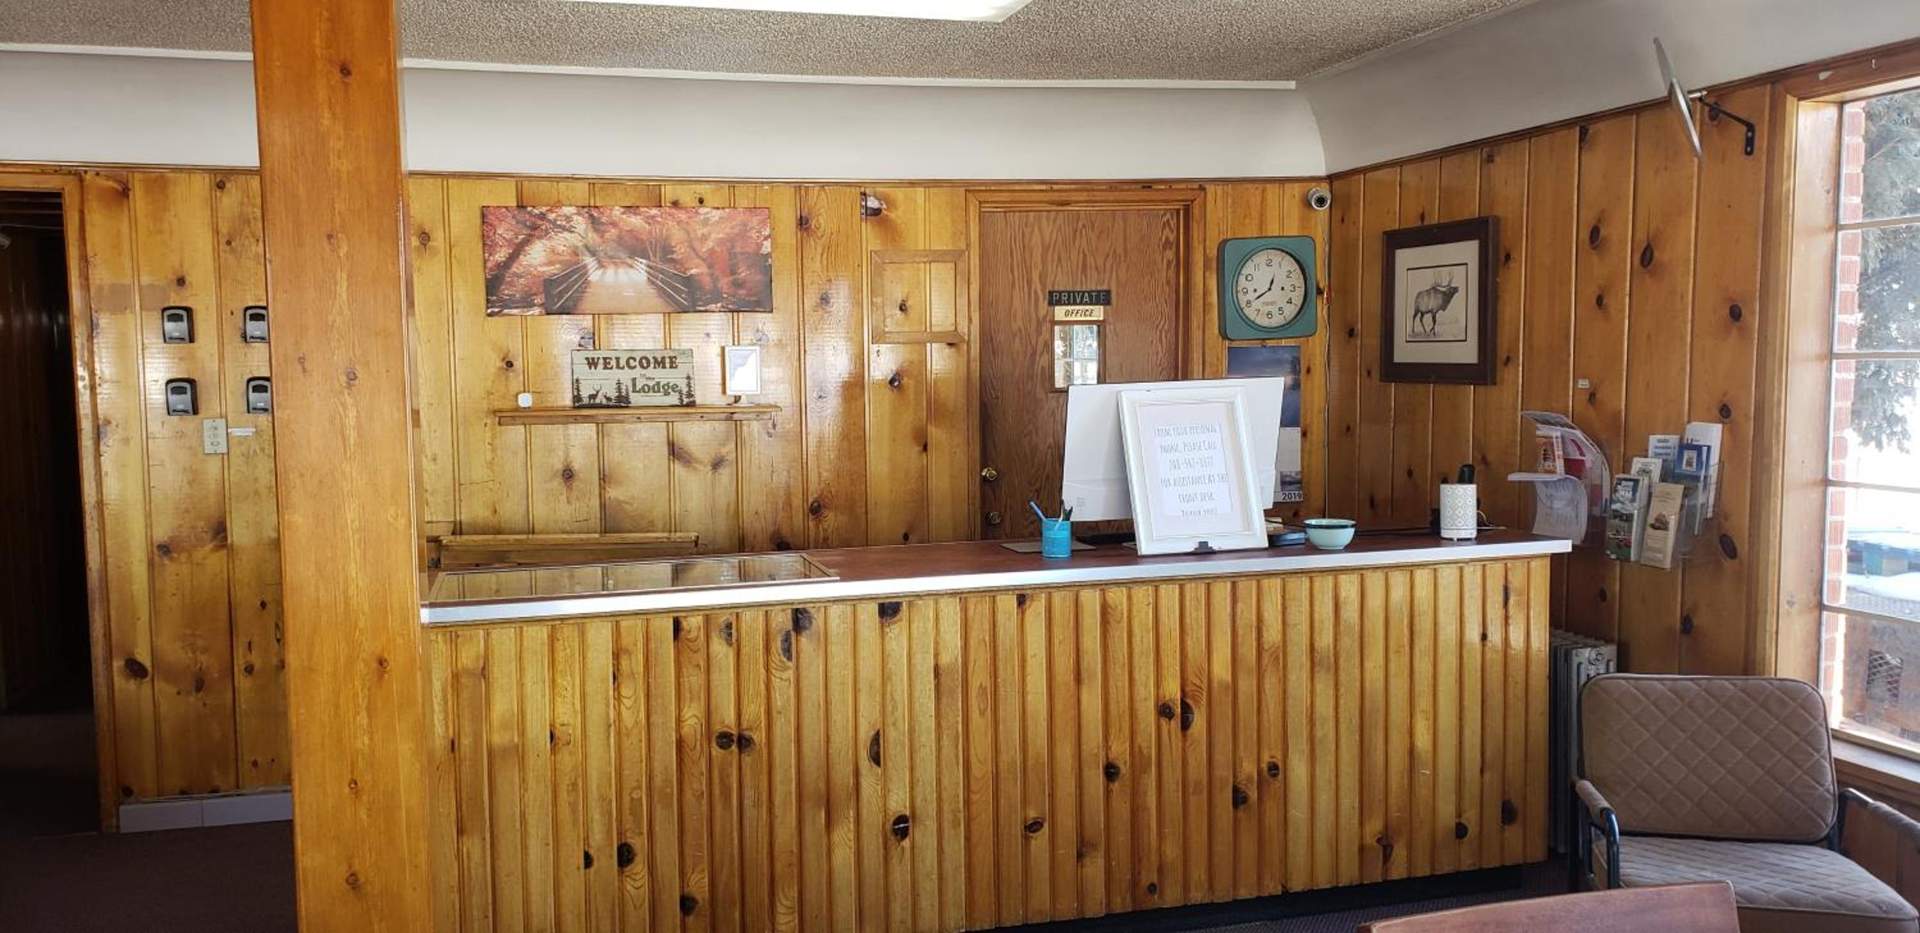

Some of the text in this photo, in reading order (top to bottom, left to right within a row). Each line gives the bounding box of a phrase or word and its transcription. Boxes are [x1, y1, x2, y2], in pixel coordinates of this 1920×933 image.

[1265, 258, 1273, 267] 12
[1253, 264, 1260, 272] 11
[1286, 270, 1293, 279] 2
[1241, 287, 1248, 295] 9
[1289, 284, 1296, 293] 3
[1052, 292, 1108, 304] PRIVATE
[1286, 297, 1293, 305] 4
[1245, 300, 1252, 308] 8
[1064, 309, 1095, 318] OFFICE
[1254, 308, 1261, 317] 7
[1266, 311, 1273, 319] 6
[1278, 307, 1285, 316] 5
[585, 356, 678, 370] WELCOME
[631, 377, 679, 396] Lodge
[1281, 492, 1303, 501] 2019
